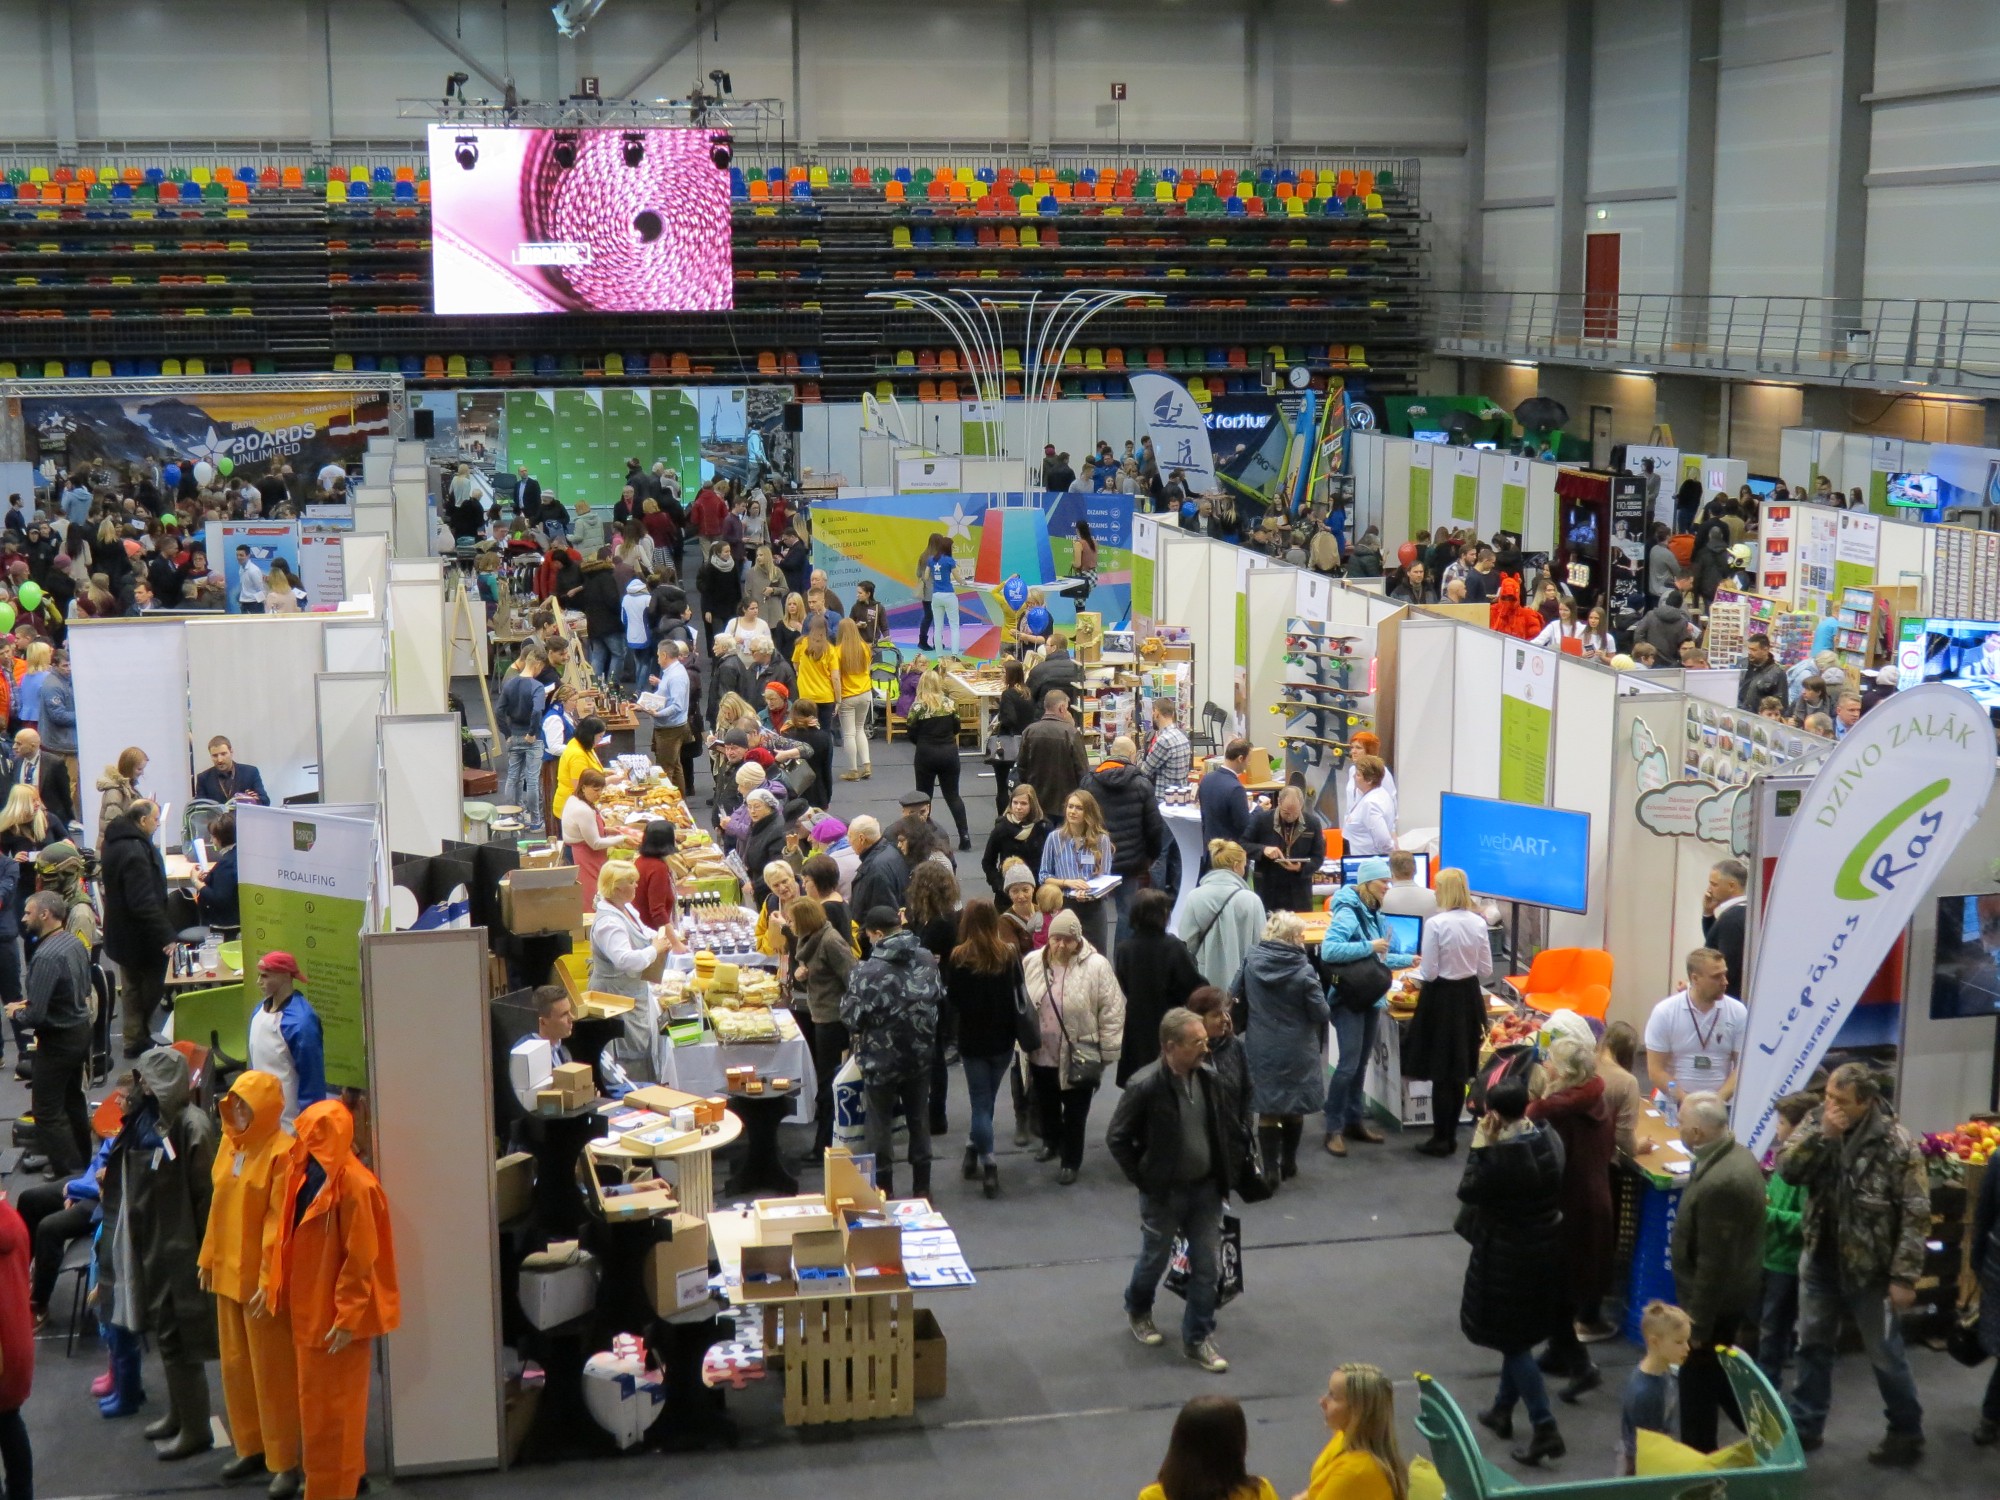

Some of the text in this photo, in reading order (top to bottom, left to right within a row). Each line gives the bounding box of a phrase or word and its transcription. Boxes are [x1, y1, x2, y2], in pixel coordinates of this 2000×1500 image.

[586, 79, 594, 93] E
[1115, 85, 1122, 99] F
[232, 422, 317, 455] BOARDS
[232, 442, 300, 467] UNLIMITED
[1887, 712, 1976, 750] ZAĻĀK
[1479, 833, 1550, 857] webART
[1870, 810, 1944, 891] Ras
[277, 868, 336, 887] PROALIFING
[1759, 914, 1860, 1056] Liepājas
